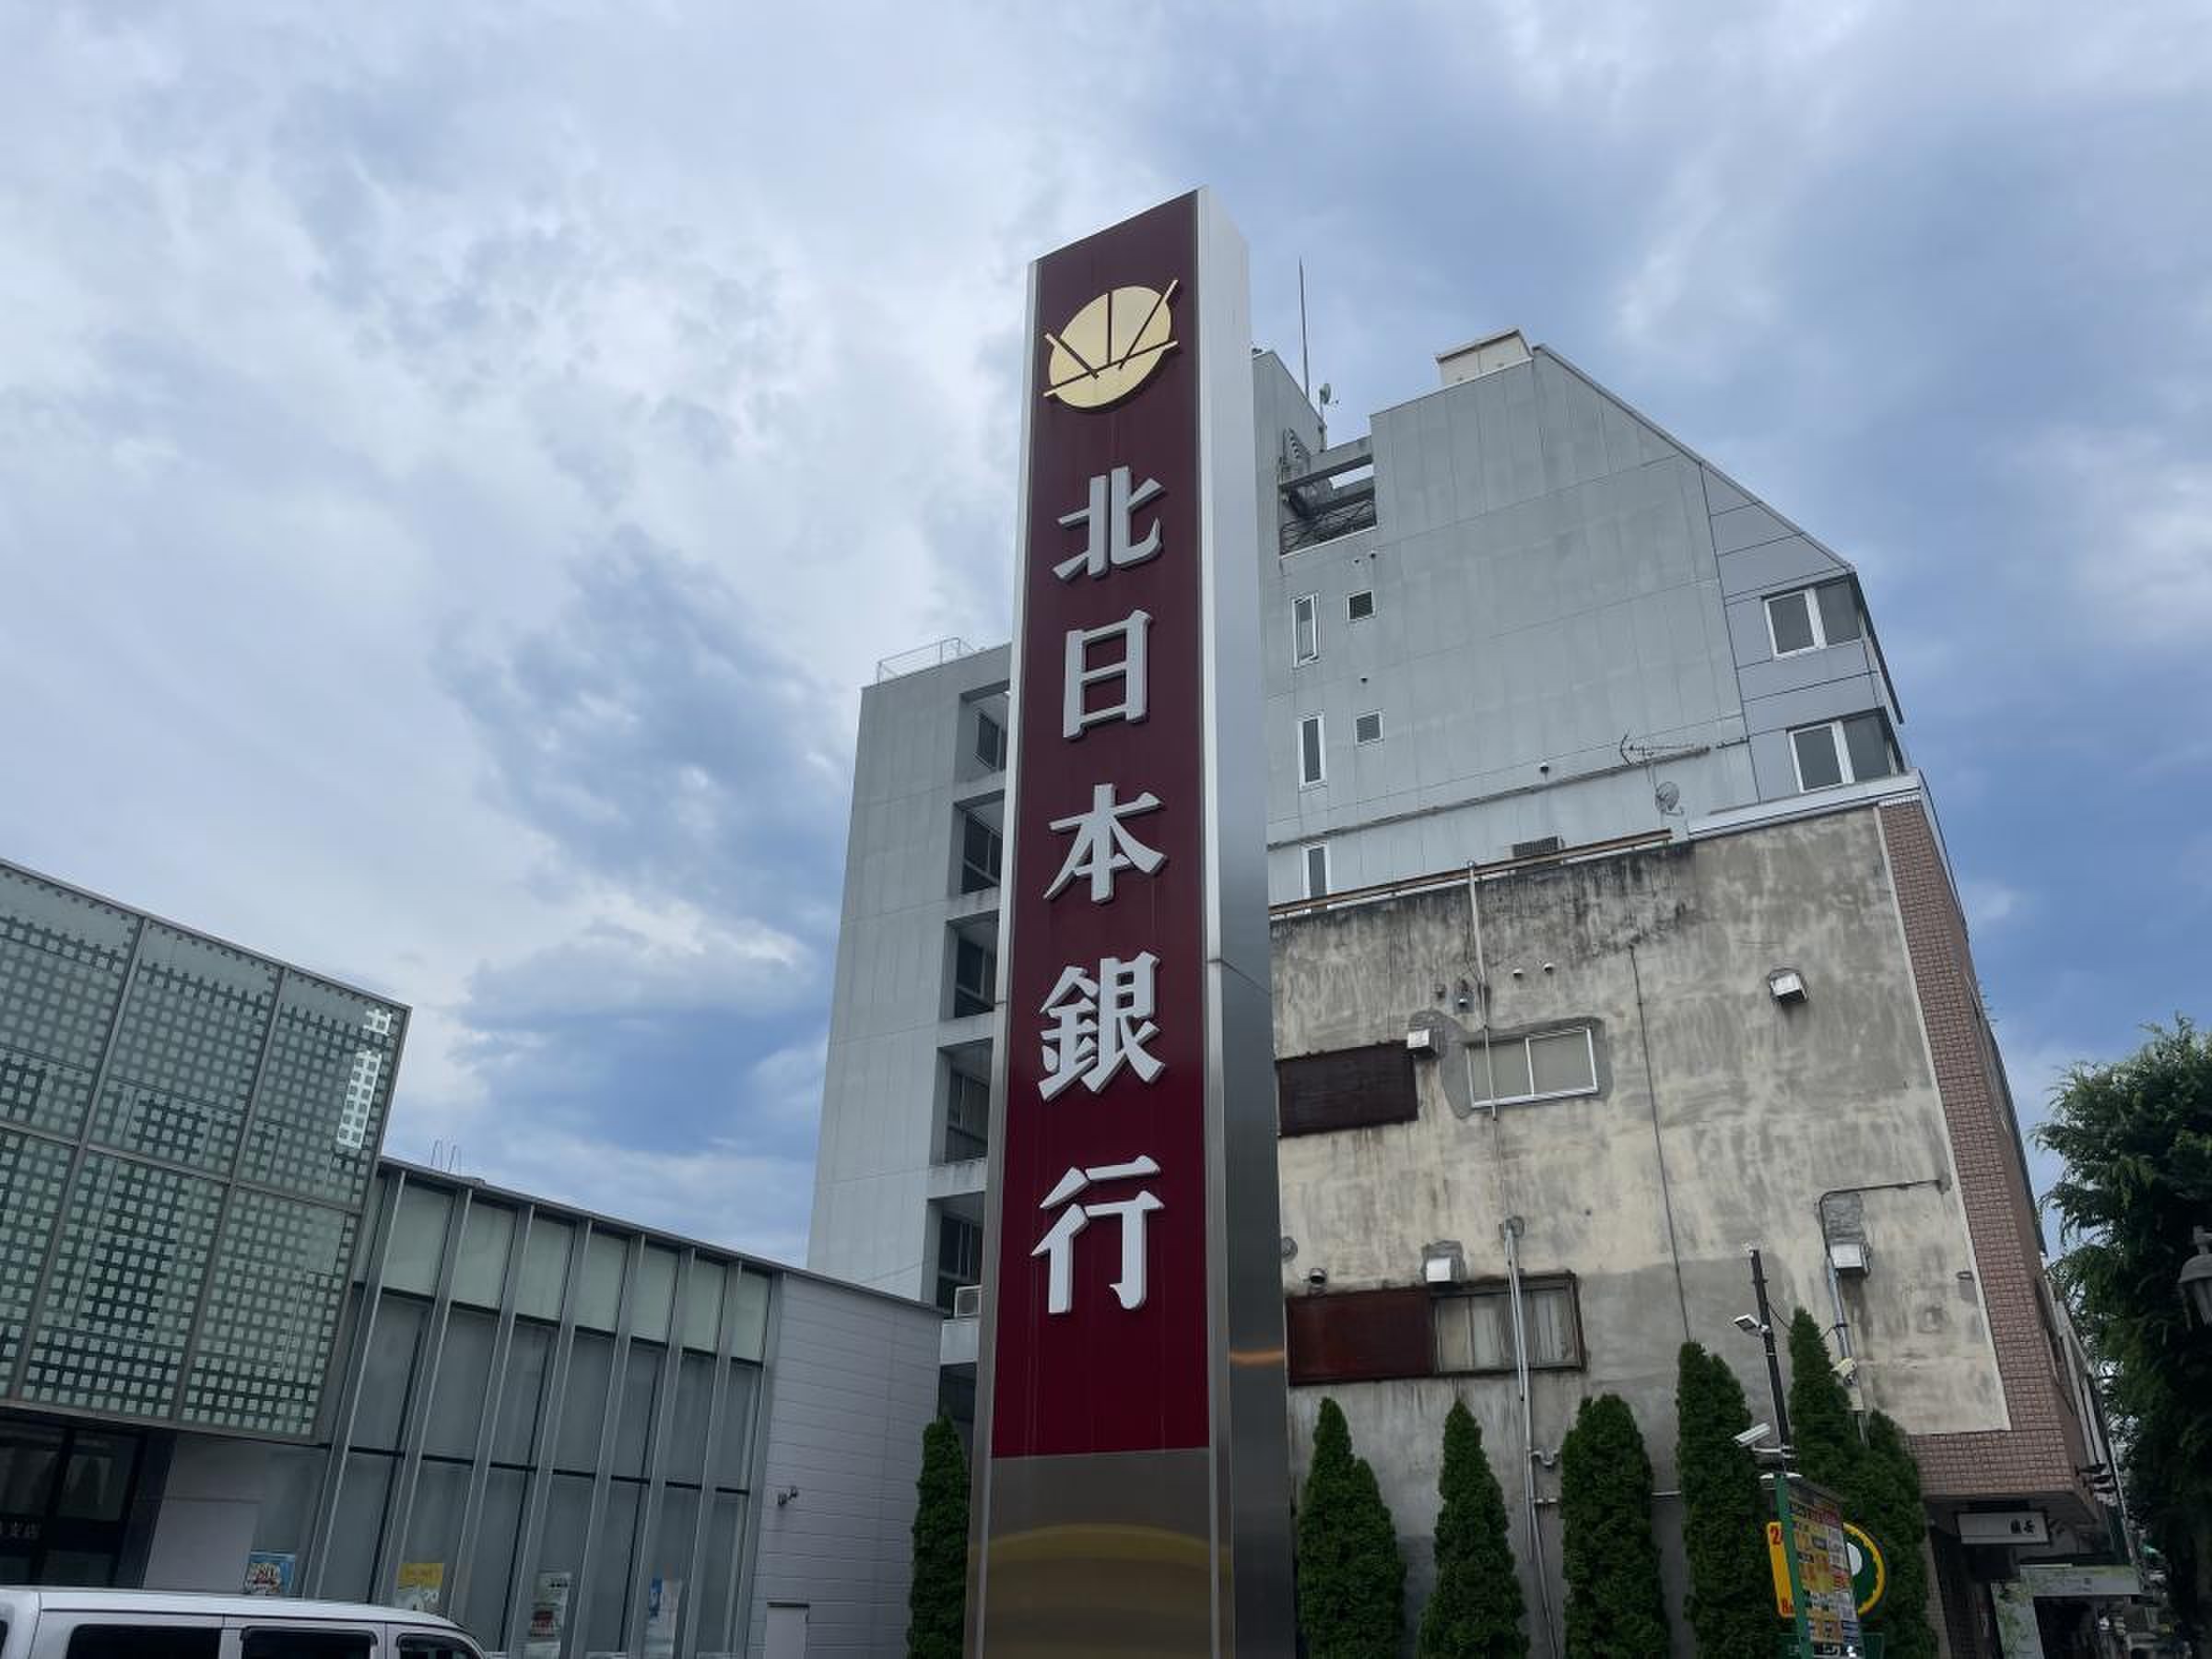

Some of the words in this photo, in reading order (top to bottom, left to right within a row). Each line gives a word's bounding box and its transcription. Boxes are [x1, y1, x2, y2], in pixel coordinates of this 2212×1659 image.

[1030, 465, 1166, 1314] 北日本銀行
